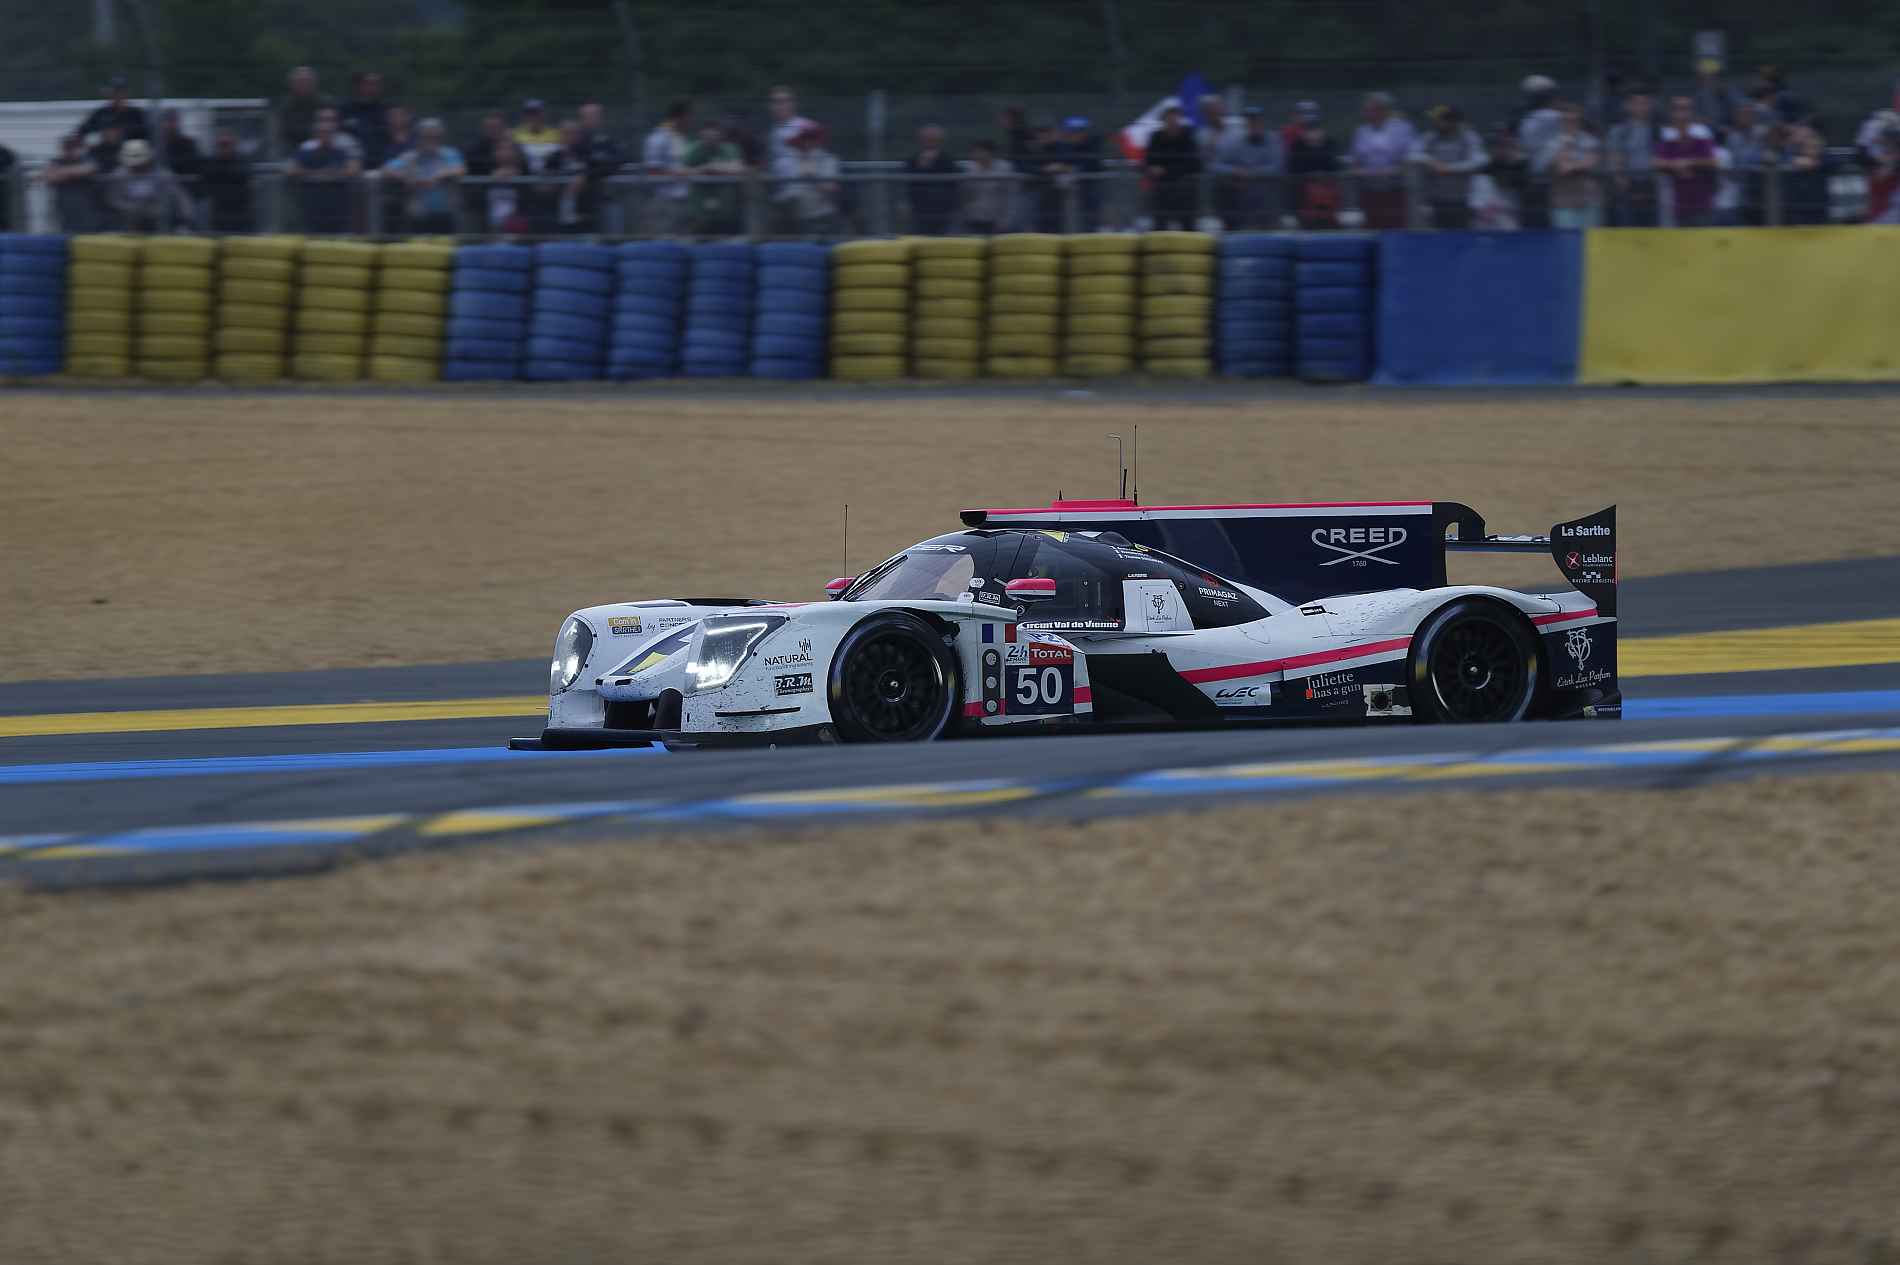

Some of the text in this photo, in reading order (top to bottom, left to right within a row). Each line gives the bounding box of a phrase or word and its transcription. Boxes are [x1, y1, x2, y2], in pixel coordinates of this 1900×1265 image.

[1311, 527, 1407, 545] CREED
[1561, 525, 1611, 537] La Sarthe
[1582, 553, 1613, 563] Leblanc
[1198, 587, 1238, 600] PRIMAGAZ
[1213, 600, 1229, 608] NEXT
[1084, 620, 1119, 628] Vienne
[764, 653, 813, 666] NATURAL
[1016, 667, 1063, 705] 50
[1305, 673, 1354, 689] Juliette
[1216, 686, 1260, 698] WEC
[1313, 683, 1361, 699] has a gun
